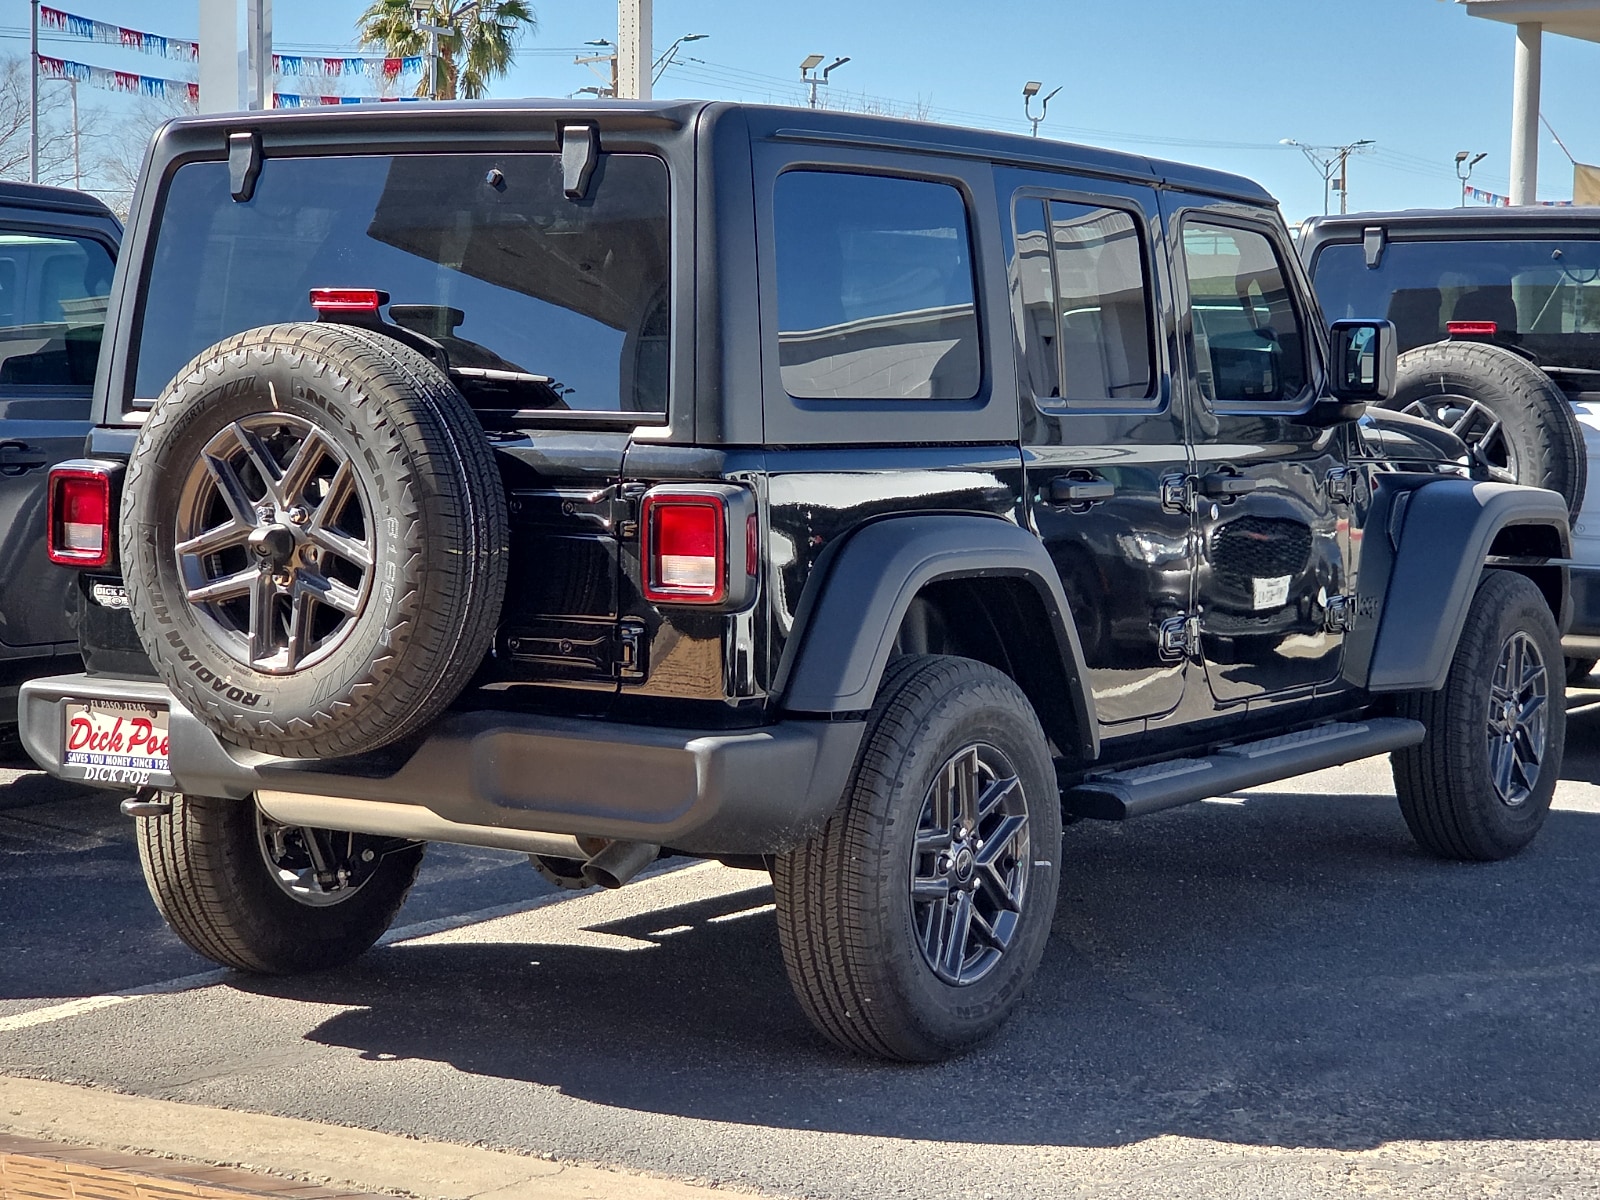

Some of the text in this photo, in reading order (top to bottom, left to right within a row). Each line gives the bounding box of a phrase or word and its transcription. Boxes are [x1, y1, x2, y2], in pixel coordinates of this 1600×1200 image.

[166, 400, 206, 451] 245/75R17
[306, 388, 389, 502] NEXEN
[96, 587, 117, 595] DICK
[165, 629, 262, 706] ROADIAN
[90, 700, 99, 708] EL
[69, 717, 169, 755] Dick Poe
[67, 753, 88, 763] SAVES
[89, 754, 104, 764] YOU
[105, 756, 131, 766] MONEY
[132, 757, 153, 768] SINCE
[84, 767, 149, 785] DICK POE
